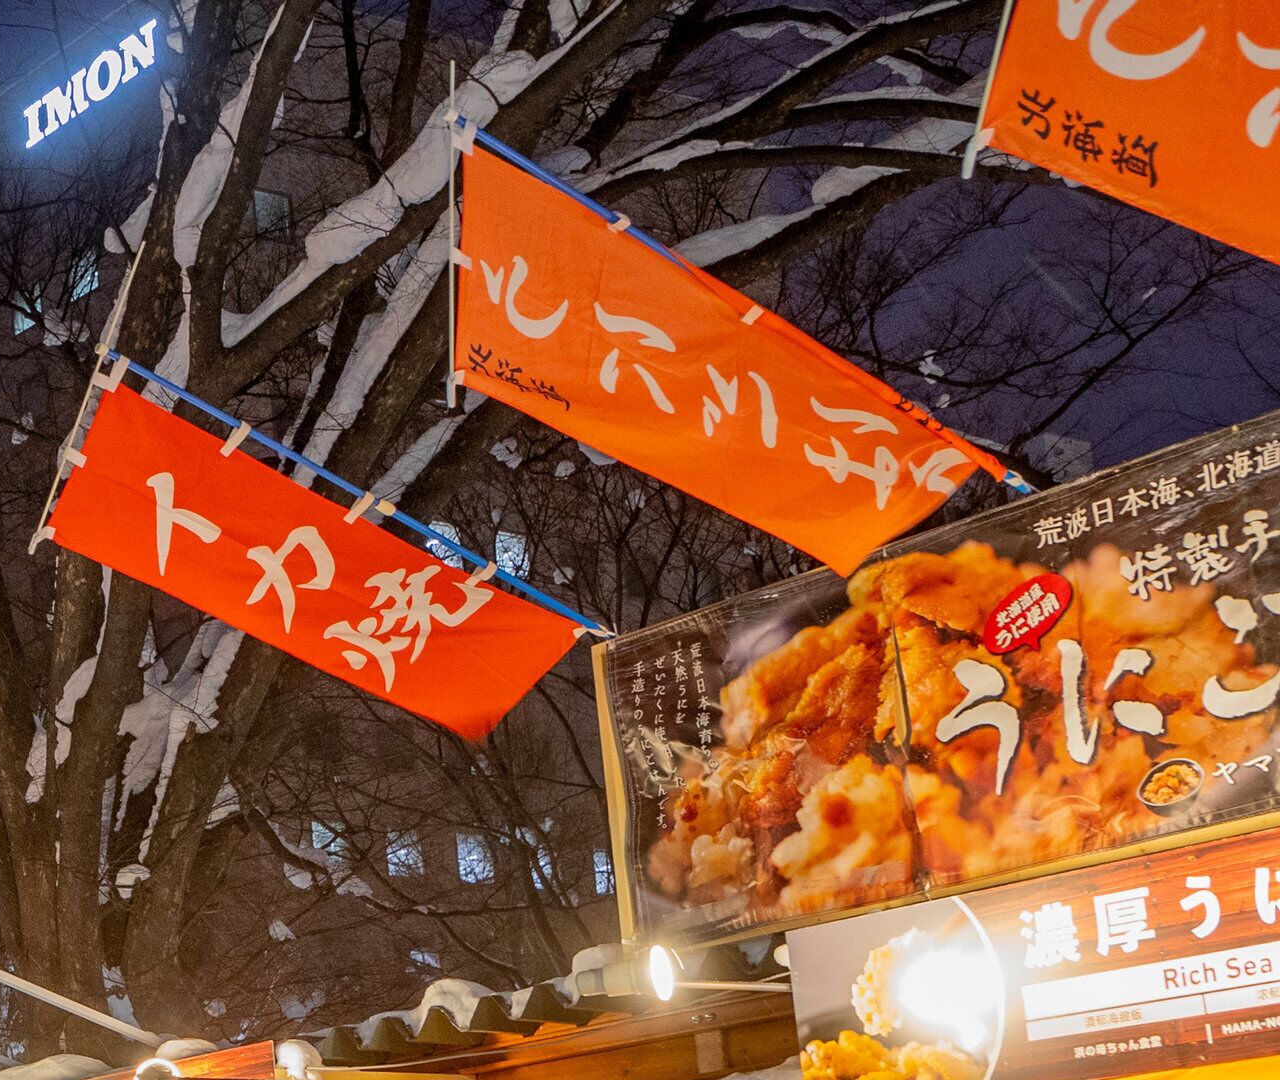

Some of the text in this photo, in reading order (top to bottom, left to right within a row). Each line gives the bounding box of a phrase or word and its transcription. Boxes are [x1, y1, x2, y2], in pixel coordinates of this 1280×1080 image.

[23, 18, 158, 149] IMON
[995, 591, 1061, 649] うに使用
[1211, 748, 1280, 785] ヤマ
[1163, 957, 1273, 990] Rich Sea
